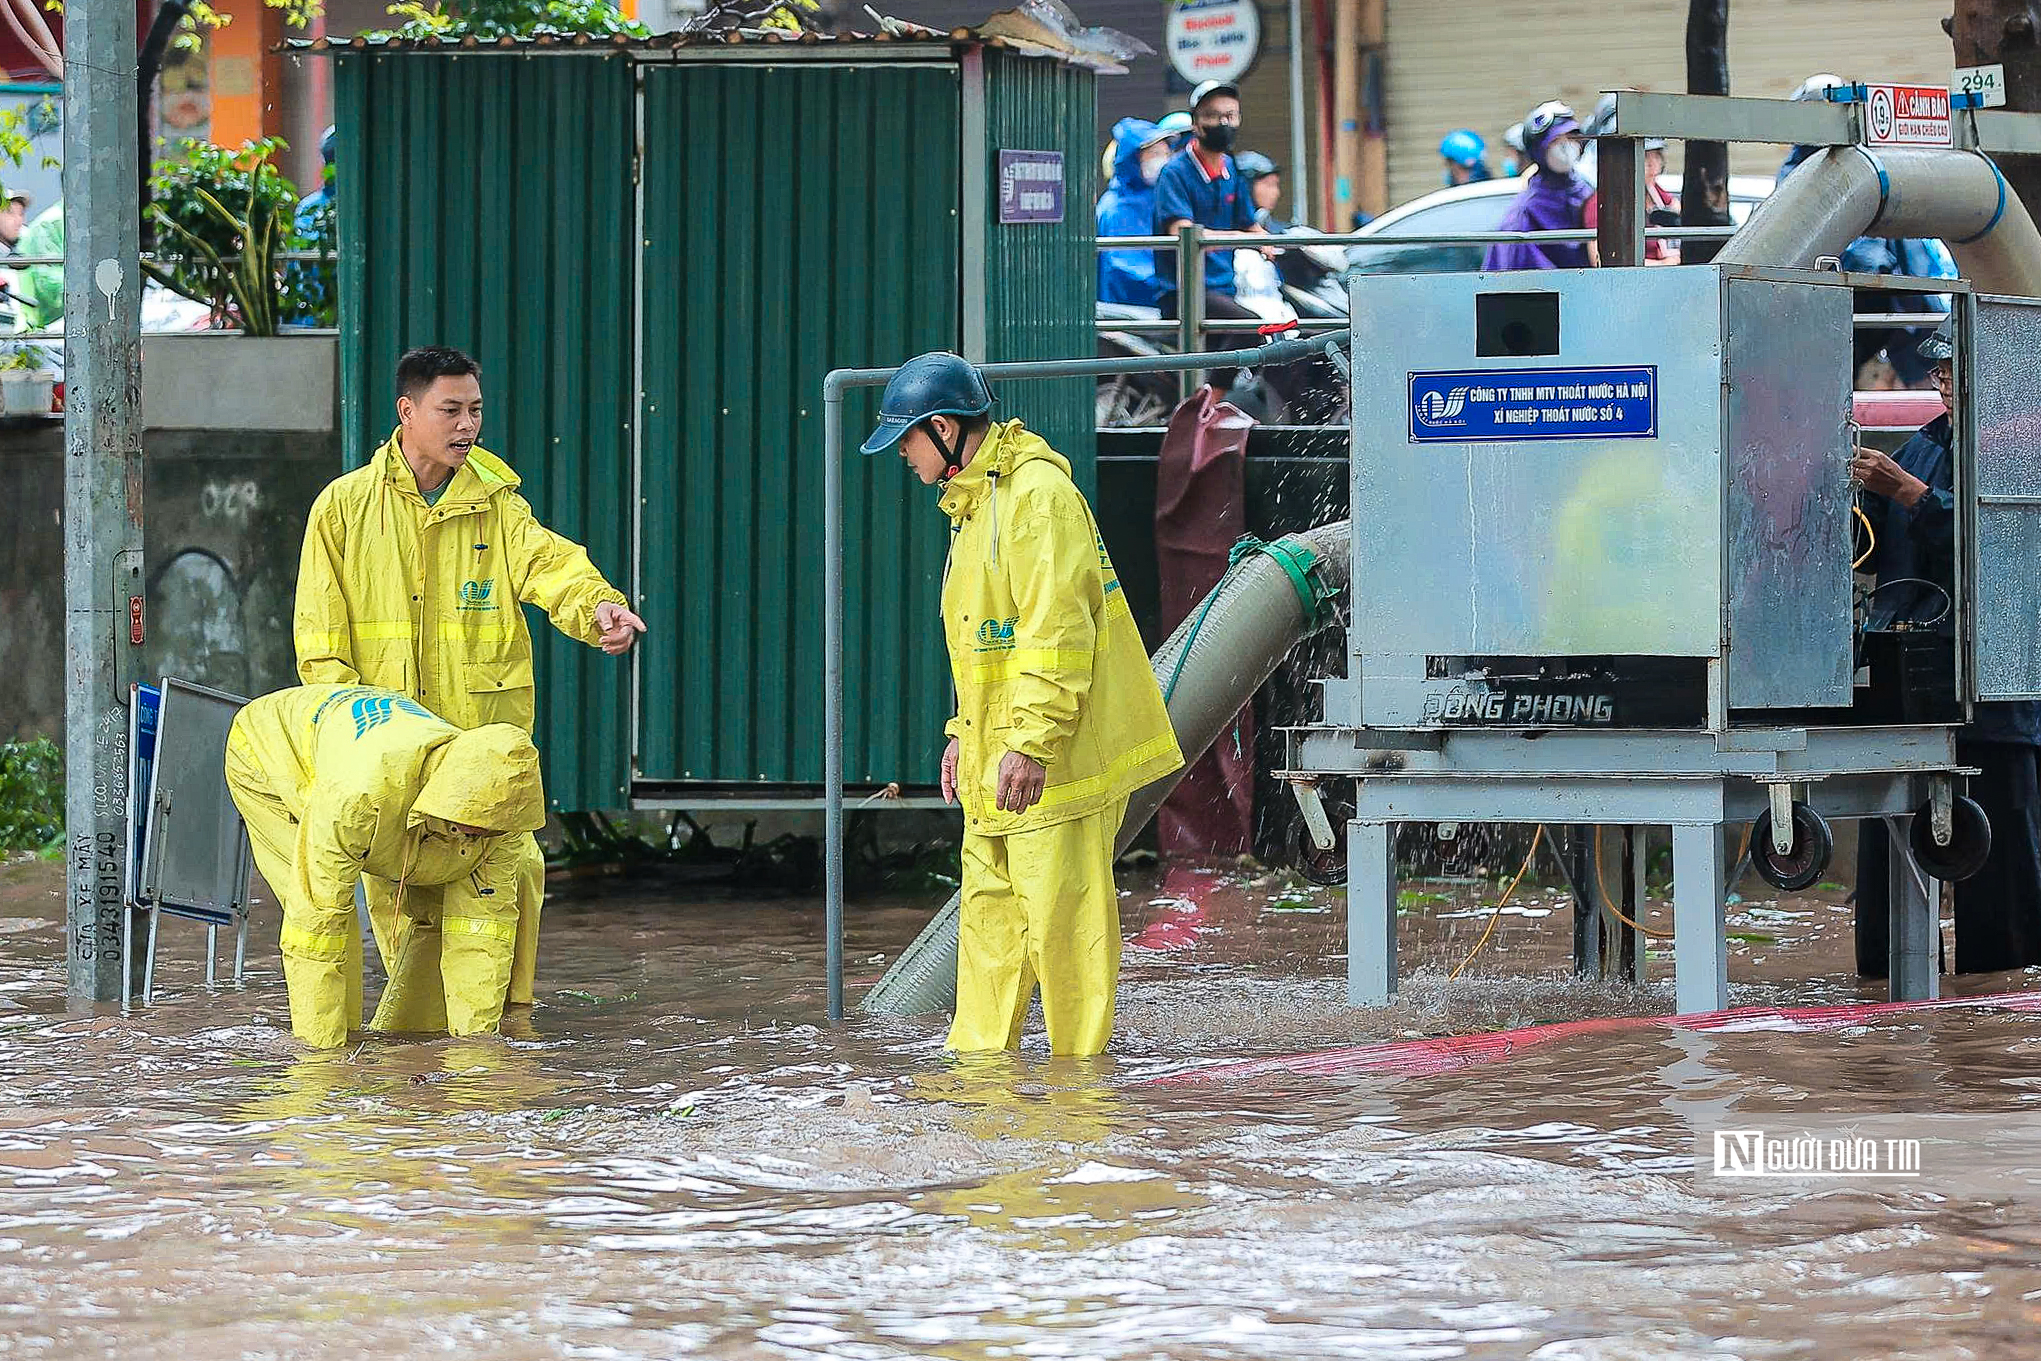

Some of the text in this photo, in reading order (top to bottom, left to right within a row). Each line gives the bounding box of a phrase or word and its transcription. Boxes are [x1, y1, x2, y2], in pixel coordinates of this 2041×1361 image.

[1961, 73, 1994, 91] 294
[1909, 90, 1947, 118] CẢNH BÁO
[1469, 381, 1648, 402] CÔNG TY TNHH MTV THOÁT NƯỚC HÀ NỘI
[1494, 402, 1624, 426] XÍ NGHIỆP THOÁT NƯỚC SỐ 4
[1511, 694, 1614, 721] PHONG
[97, 832, 121, 961] 0343191540
